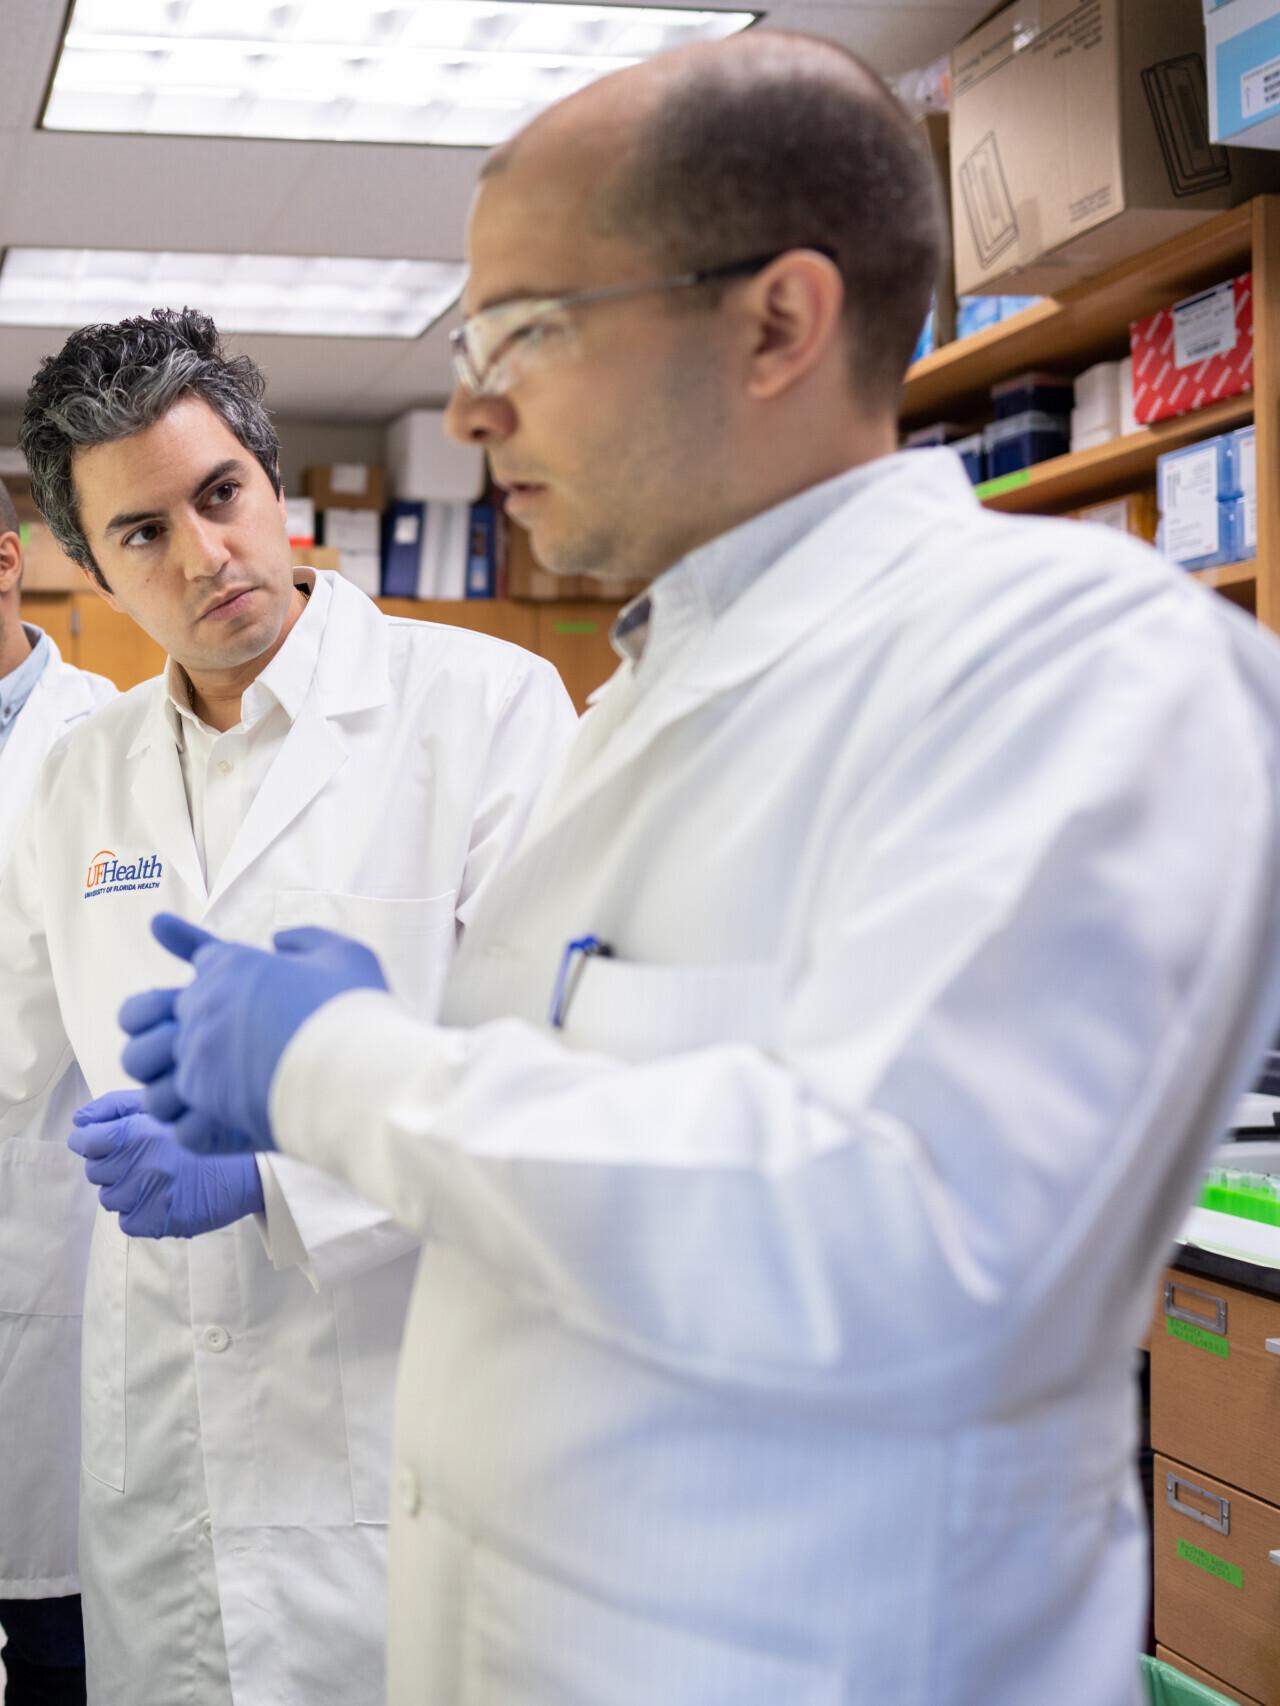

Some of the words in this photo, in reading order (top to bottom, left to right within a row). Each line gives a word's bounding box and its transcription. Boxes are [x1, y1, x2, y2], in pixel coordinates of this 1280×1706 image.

[84, 887, 107, 899] UNIVERSITY
[106, 885, 114, 894] OF
[113, 883, 137, 893] FLORIDA
[137, 881, 161, 890] HEALTH
